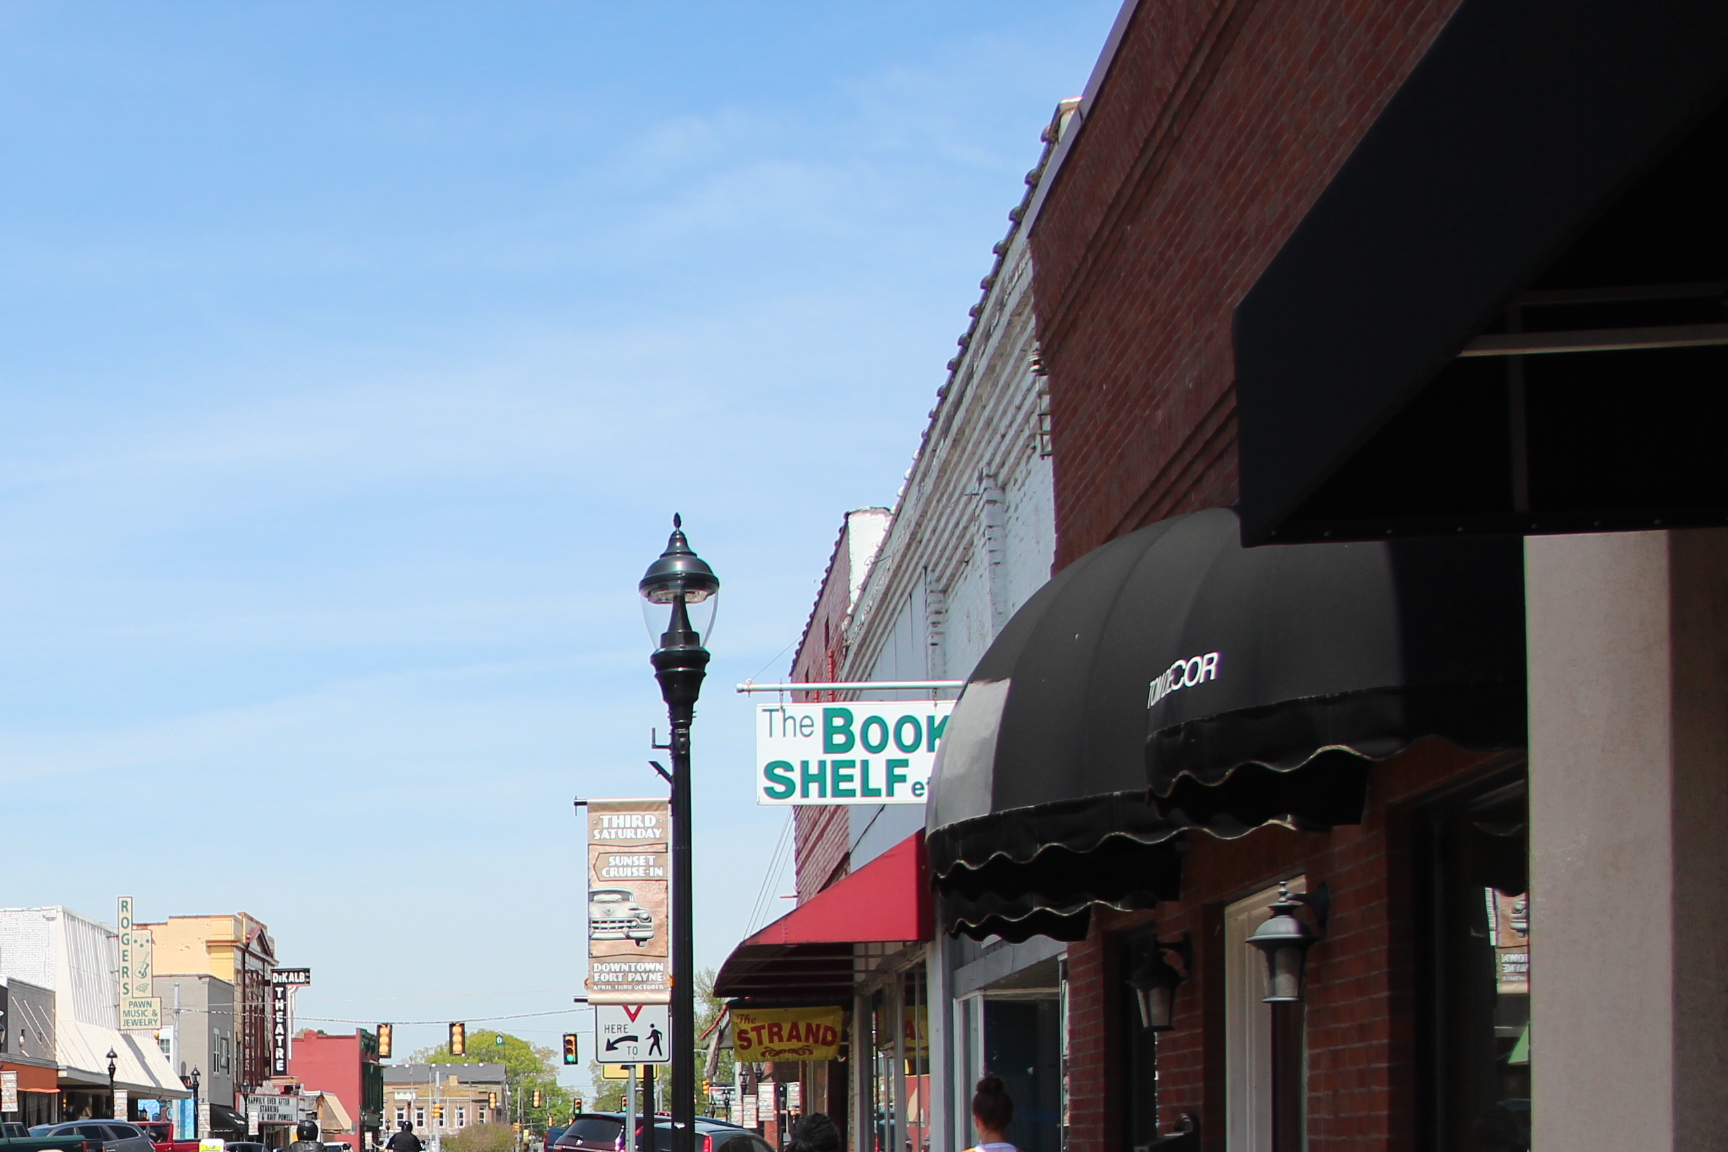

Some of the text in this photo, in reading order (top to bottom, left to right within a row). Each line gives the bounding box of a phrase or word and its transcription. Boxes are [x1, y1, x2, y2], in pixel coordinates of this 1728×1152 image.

[762, 708, 814, 738] The
[763, 759, 909, 799] SHELF
[599, 814, 656, 828] THIRD
[593, 828, 662, 839] SATURDAY
[609, 856, 655, 866] SUNSET
[601, 867, 663, 877] CRUISE-IN
[121, 900, 130, 995] ROGERS
[593, 963, 663, 972] DOWNTOWN
[594, 973, 662, 982] FORT PAYNE
[123, 1009, 158, 1017] MUSIC &
[123, 1018, 158, 1027] JEWELRY
[736, 1013, 756, 1025] The
[275, 987, 284, 1072] THEATRE
[604, 1024, 628, 1034] HERE
[736, 1022, 838, 1051] STRAND
[627, 1046, 638, 1056] TO
